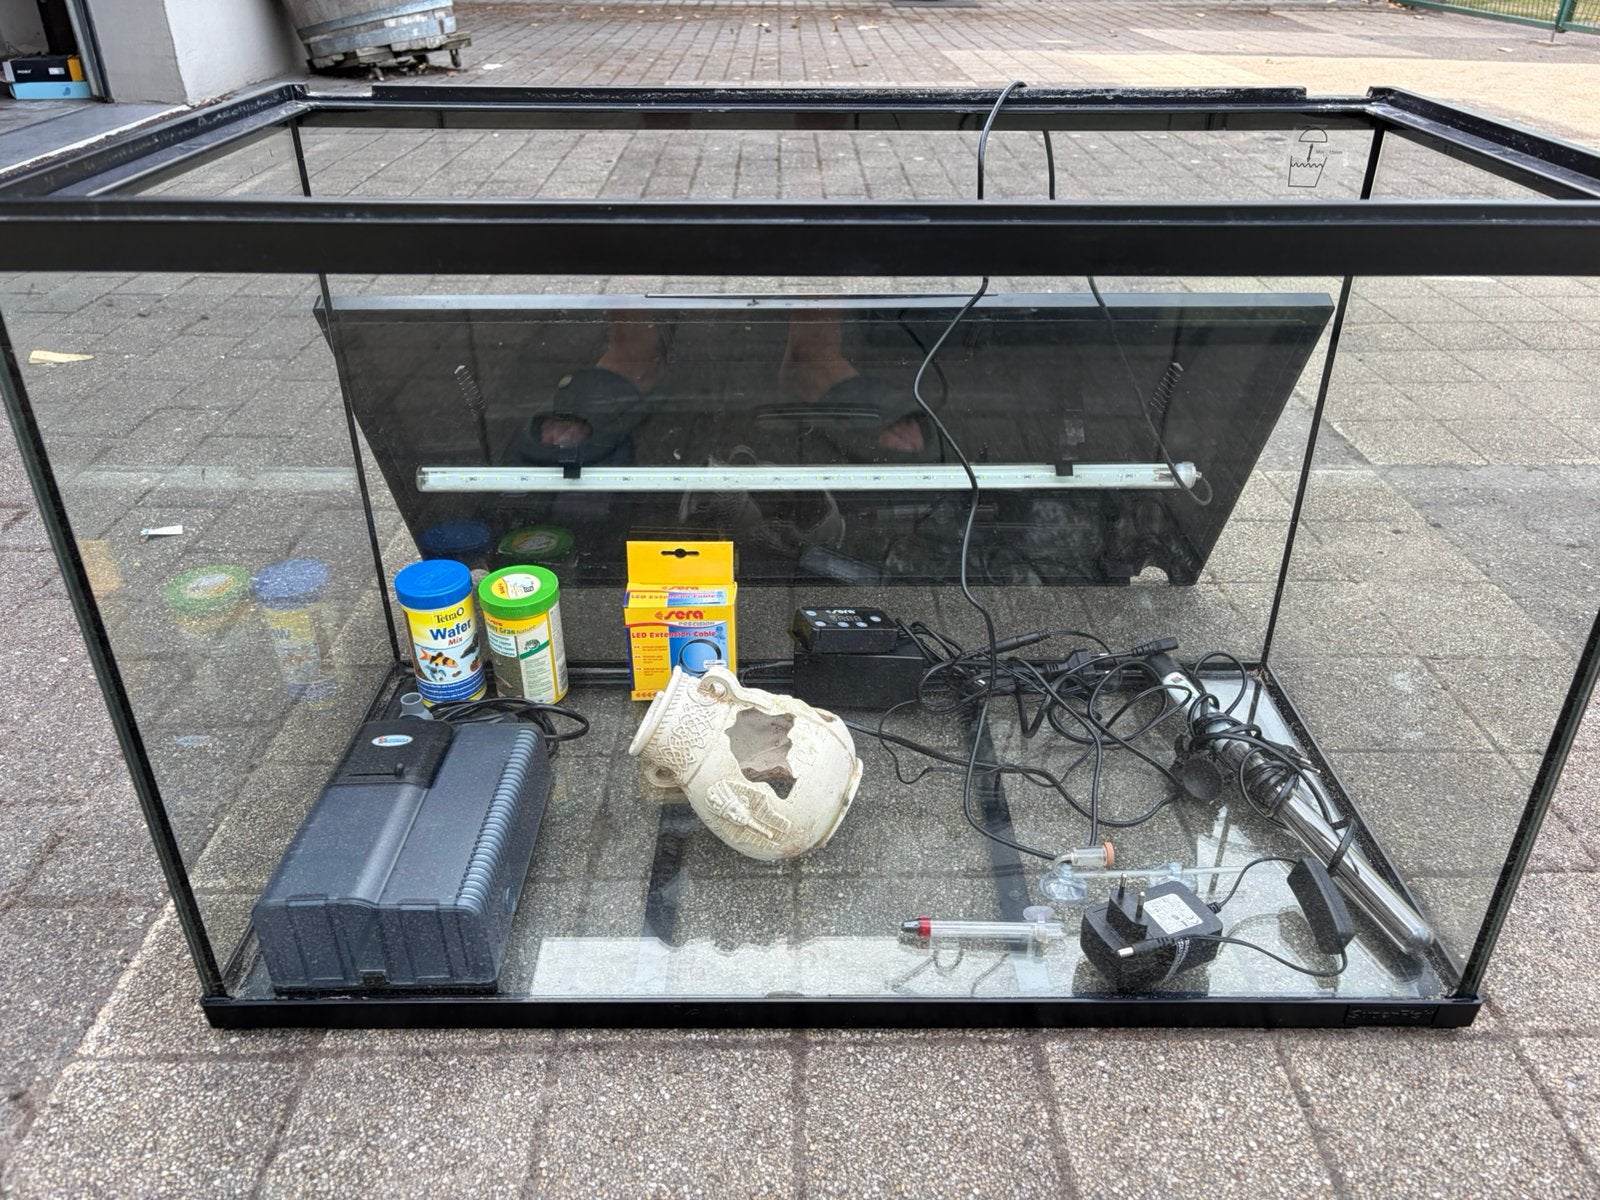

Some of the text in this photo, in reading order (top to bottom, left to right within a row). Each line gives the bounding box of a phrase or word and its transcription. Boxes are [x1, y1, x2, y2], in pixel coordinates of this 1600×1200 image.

[664, 609, 704, 621] sera
[429, 619, 473, 641] Wafer
[631, 631, 648, 639] LED
[693, 630, 716, 638] Cable
[447, 637, 463, 646] Mix
